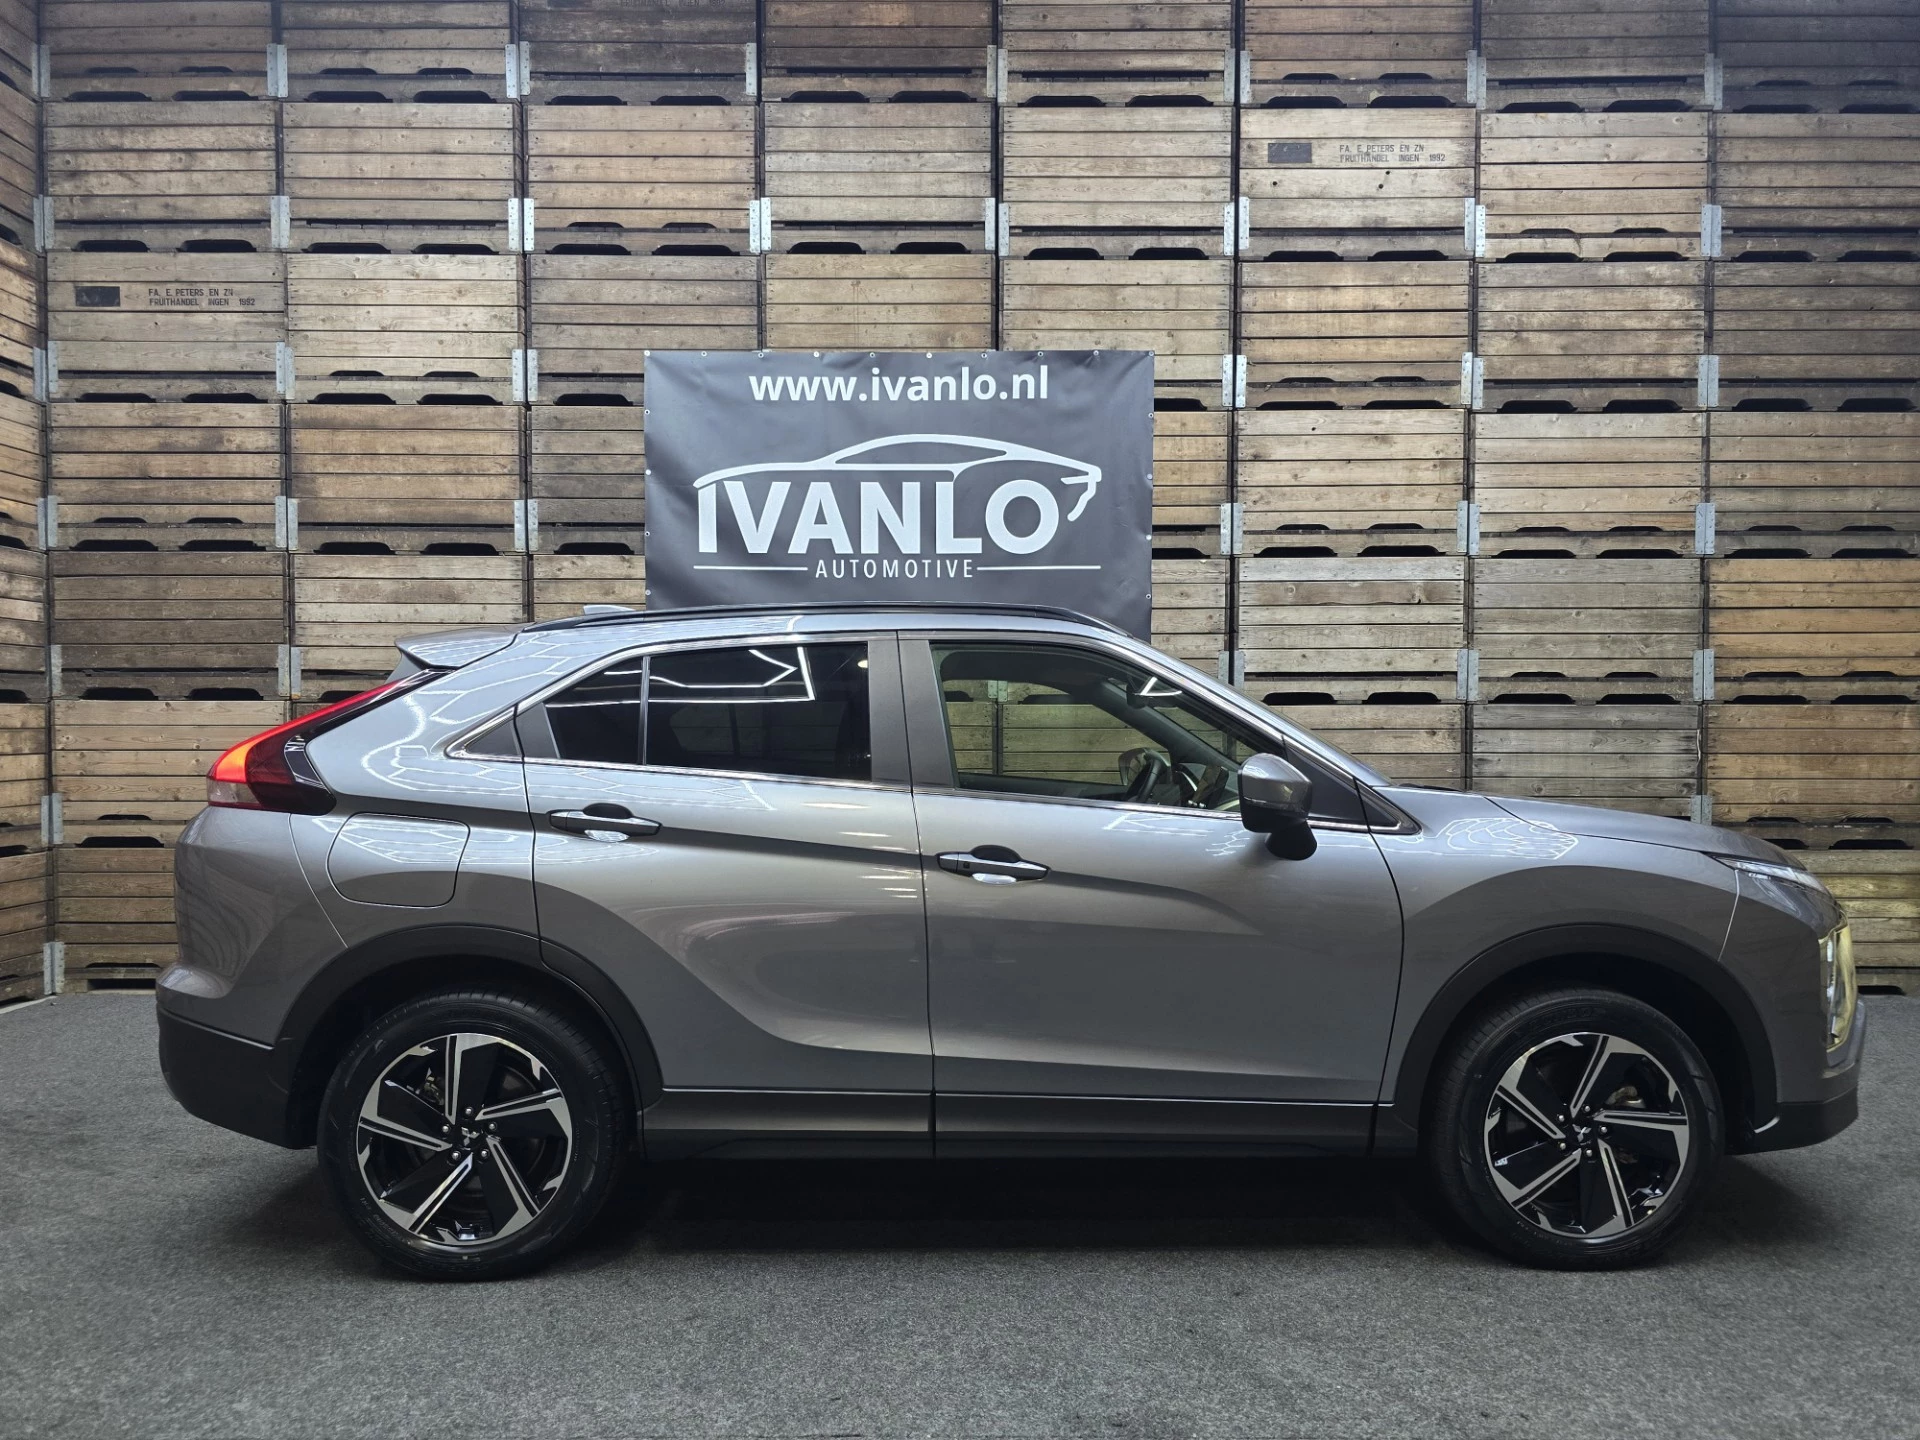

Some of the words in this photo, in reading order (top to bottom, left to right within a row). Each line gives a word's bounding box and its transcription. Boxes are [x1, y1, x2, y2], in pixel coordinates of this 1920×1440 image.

[1366, 144, 1395, 153] PETERS
[1399, 144, 1410, 153] EN
[1414, 144, 1425, 153] ZN
[1429, 154, 1446, 162] 1992
[149, 298, 199, 306] FRUITHANDEL
[239, 298, 255, 306] 1992
[749, 365, 1048, 402] www.ivanlo.nl
[697, 479, 1060, 556] IVANLO
[815, 560, 974, 579] AUTOMOTIVE
